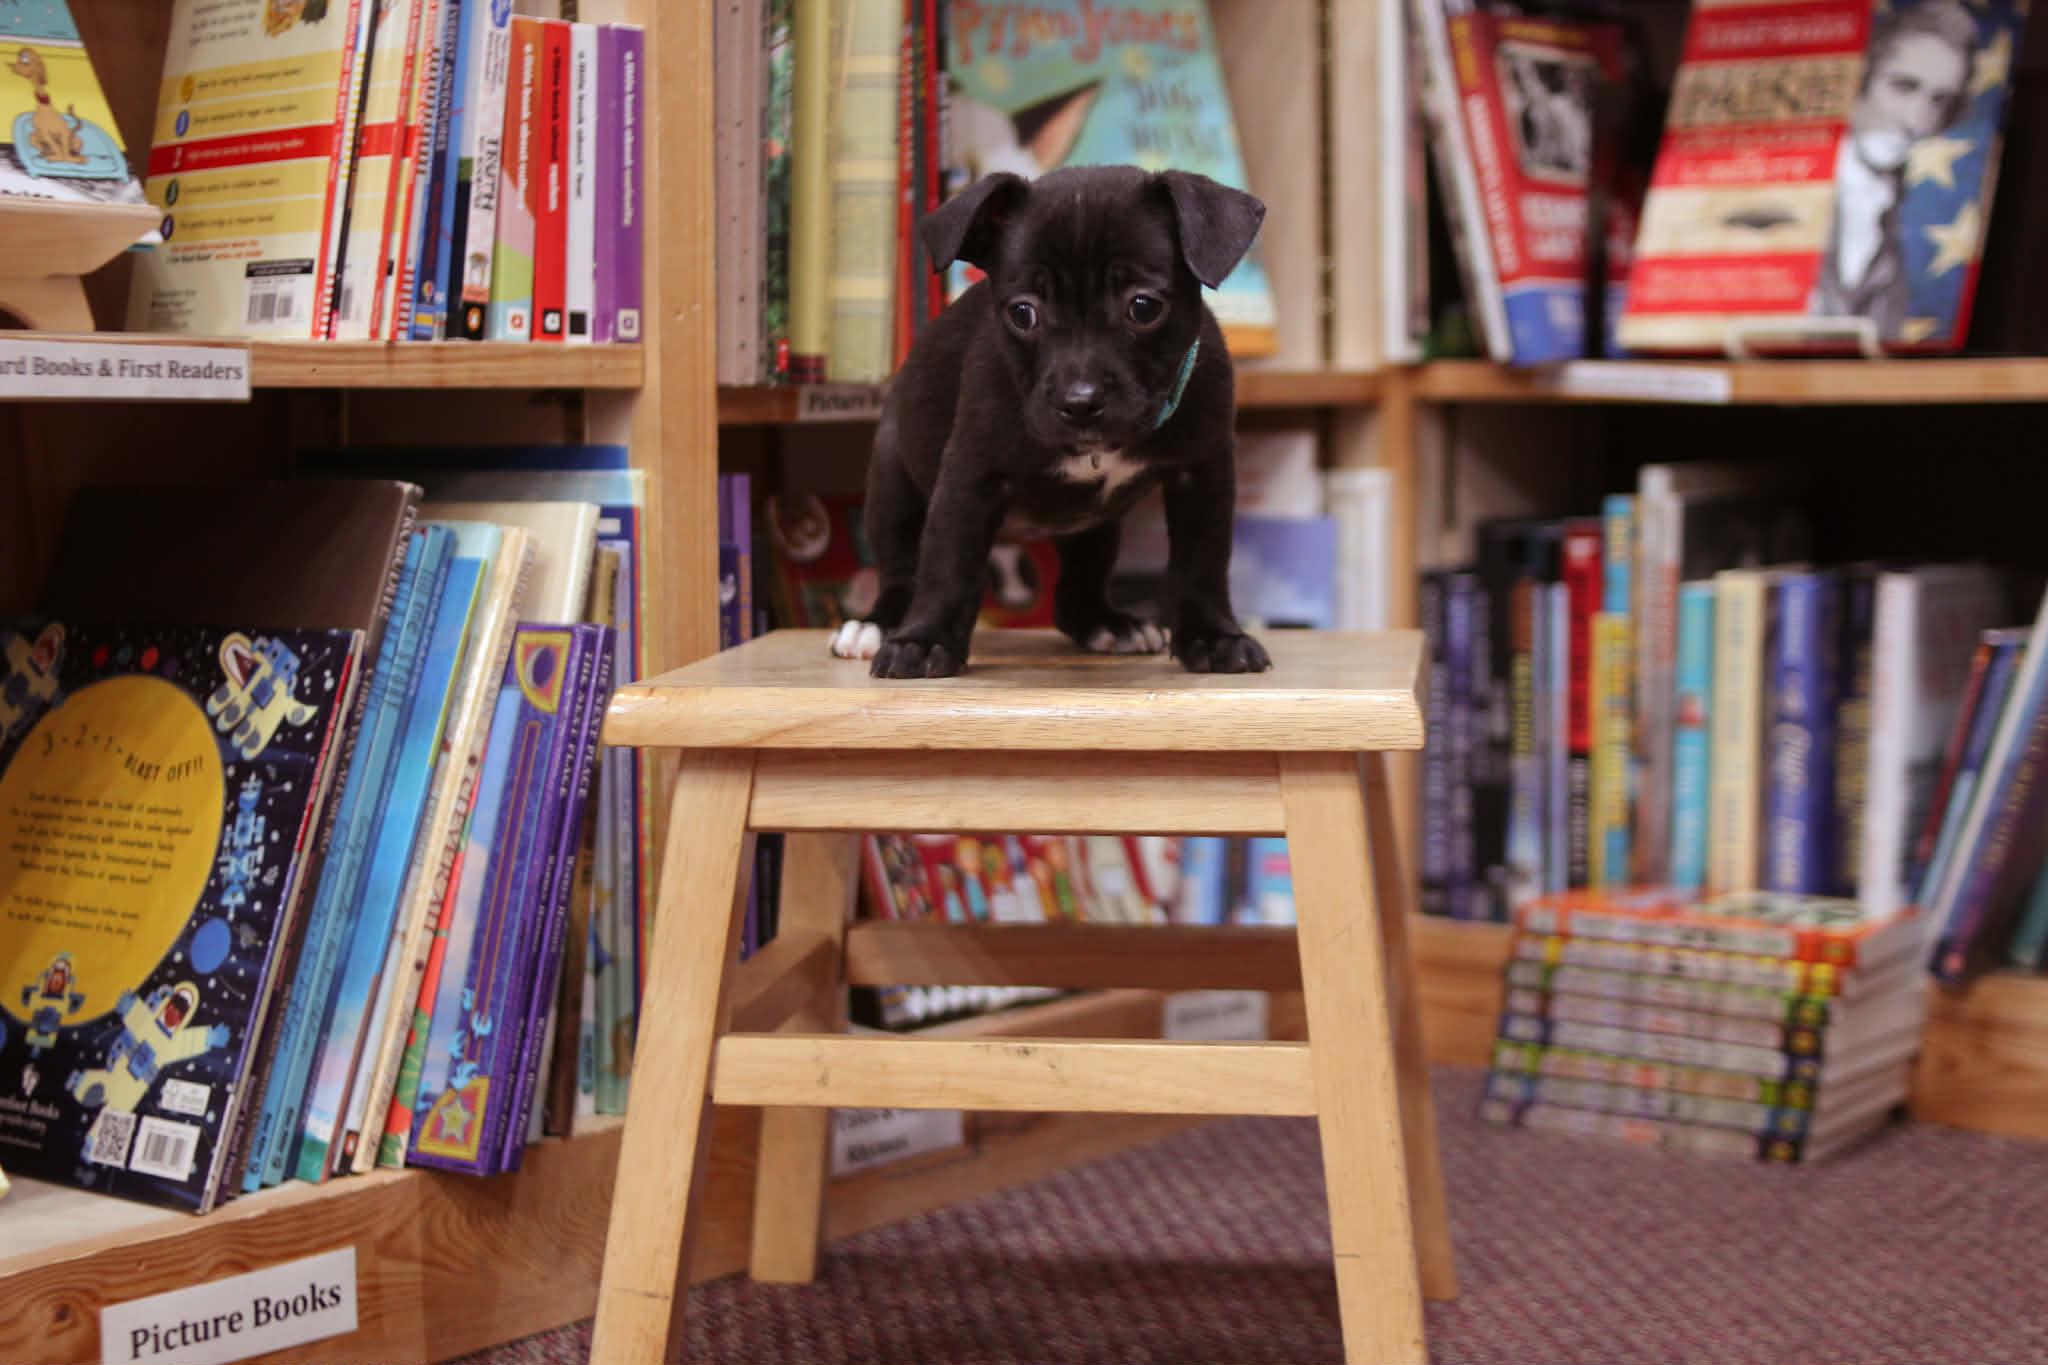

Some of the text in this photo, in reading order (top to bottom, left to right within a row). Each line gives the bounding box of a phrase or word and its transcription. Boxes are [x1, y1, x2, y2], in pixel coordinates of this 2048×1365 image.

[483, 137, 499, 210] TRUTH
[32, 356, 93, 378] Books
[97, 358, 113, 378] &
[118, 358, 163, 380] First
[168, 360, 244, 381] Readers
[559, 651, 593, 800] THE NEXT PLACE
[578, 652, 613, 800] THE NEXT PLACE
[436, 777, 471, 879] CLEVER
[130, 1282, 342, 1360] Picture Books
